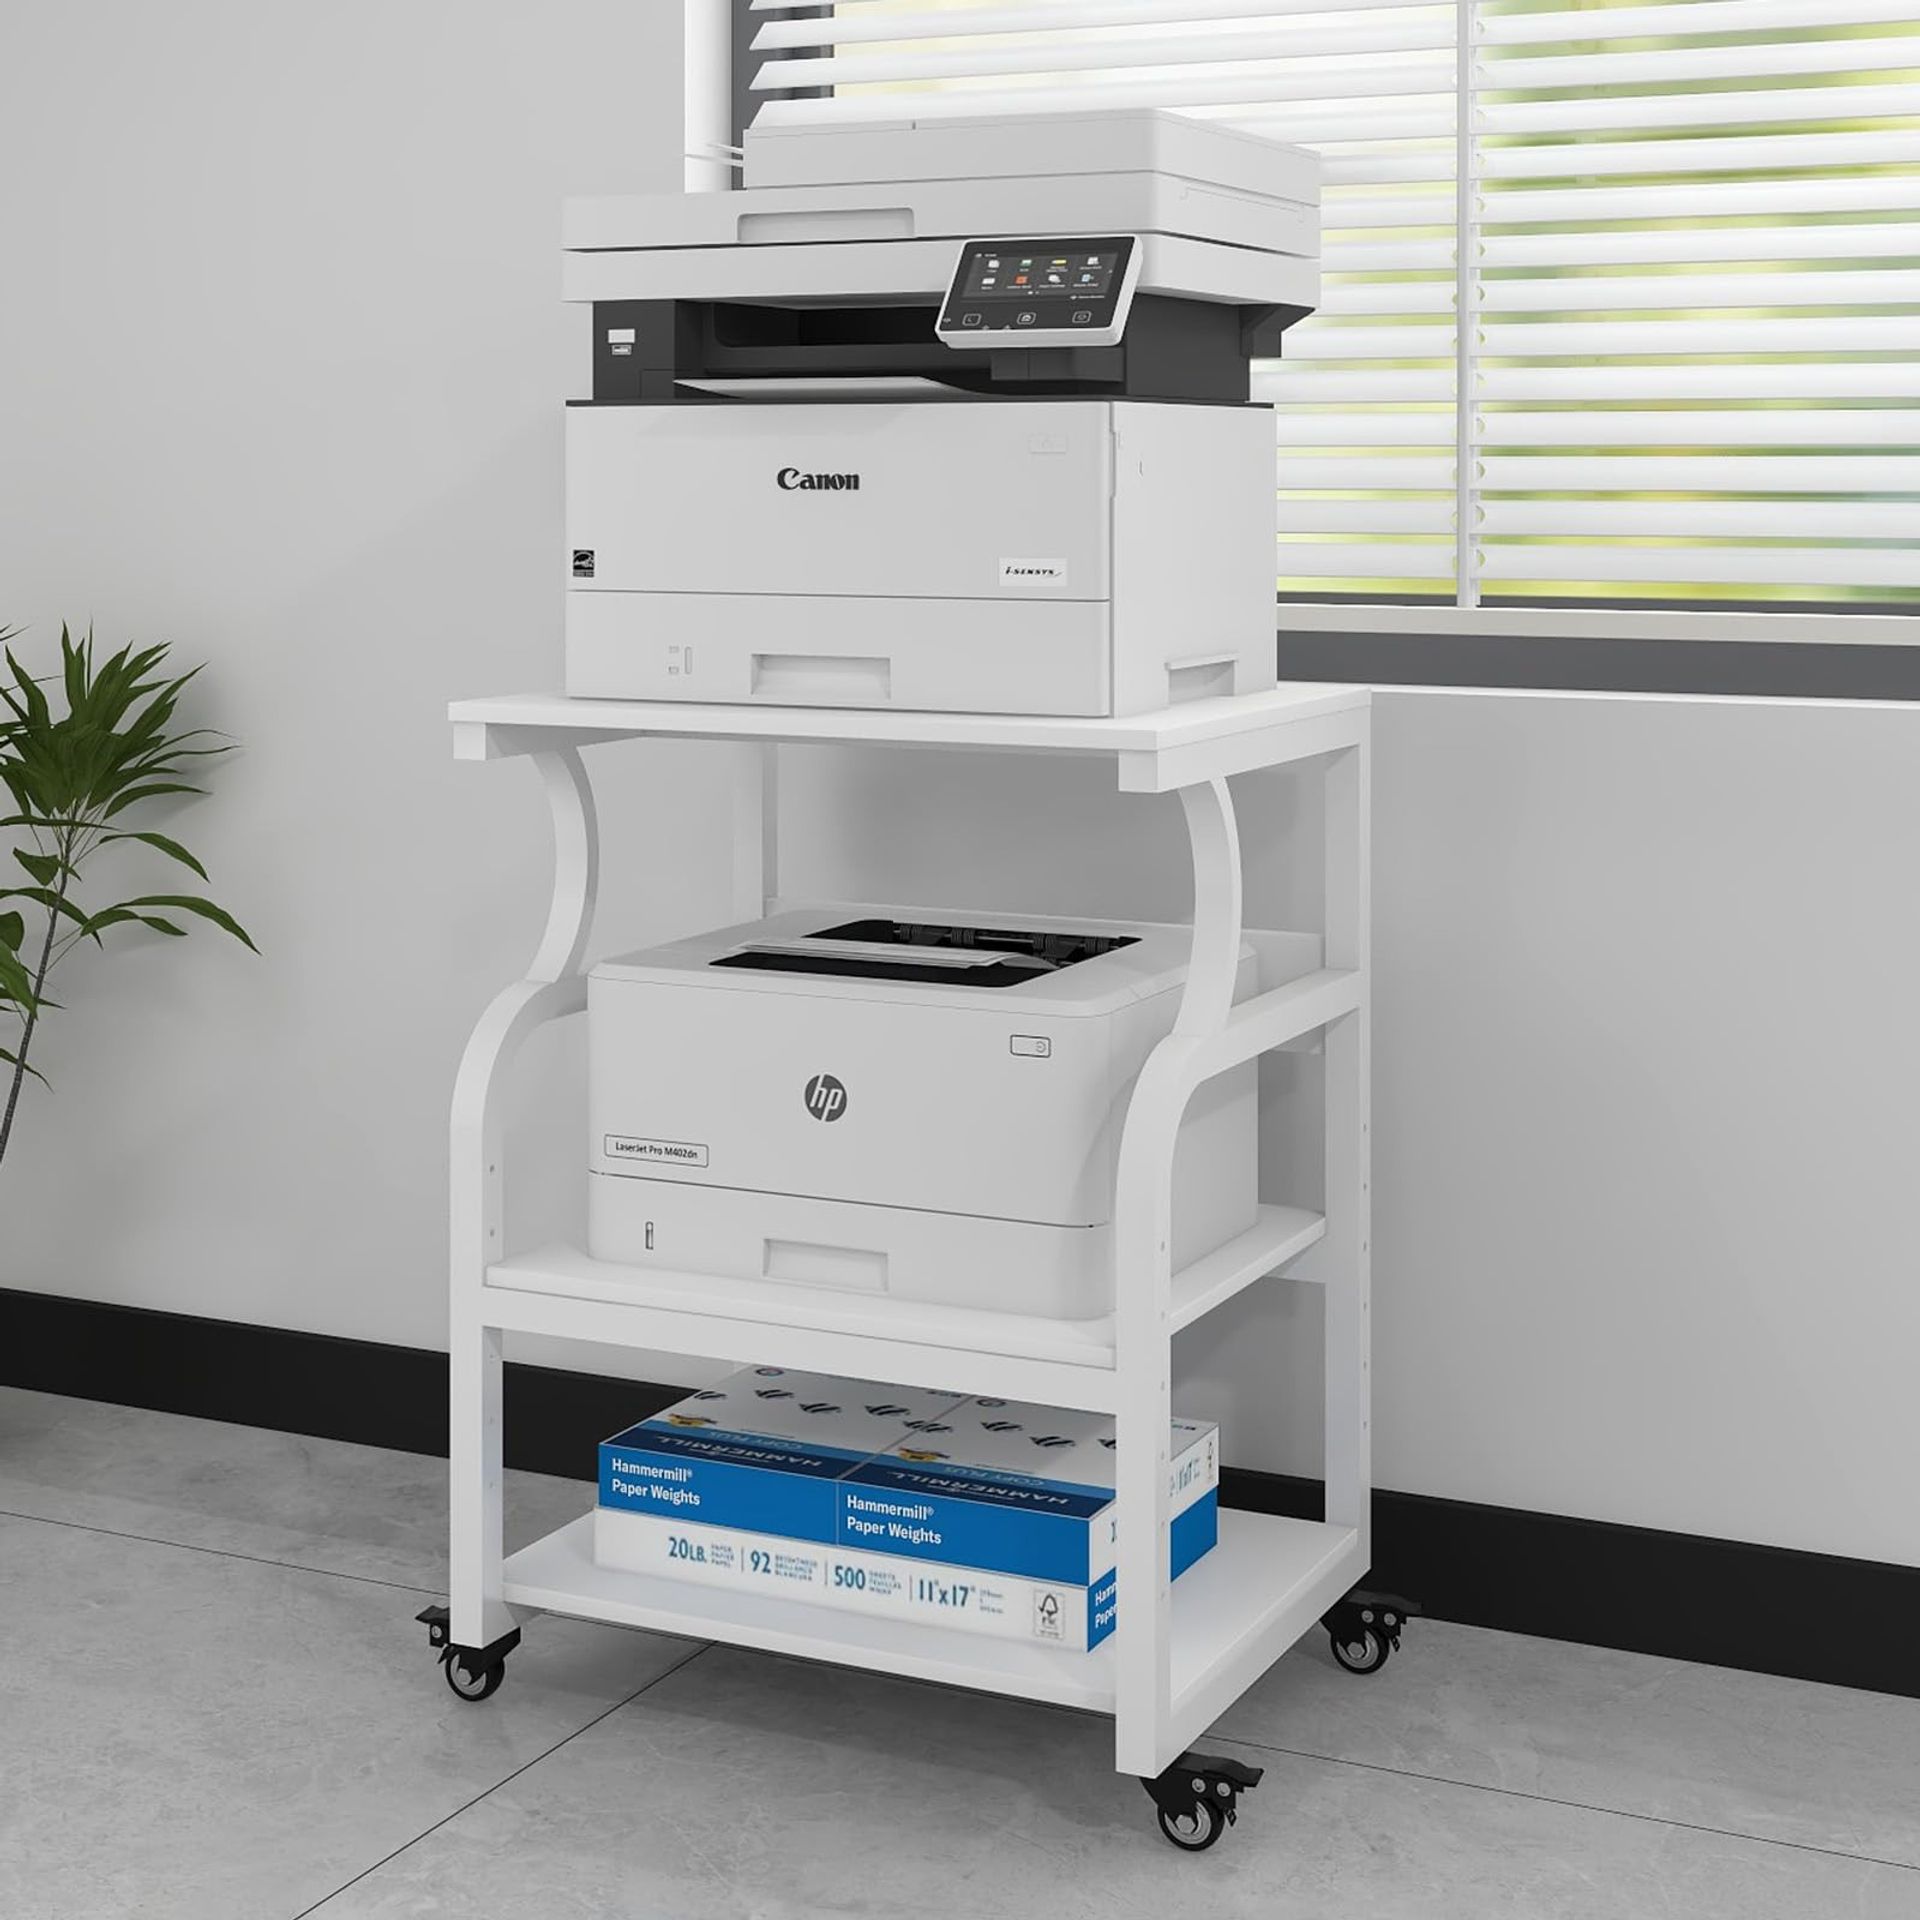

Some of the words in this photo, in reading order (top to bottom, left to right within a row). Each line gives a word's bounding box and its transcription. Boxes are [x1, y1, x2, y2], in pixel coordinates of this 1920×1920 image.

[777, 467, 860, 490] Canon
[808, 1074, 844, 1122] hp
[616, 1142, 647, 1154] LaserJet
[649, 1145, 663, 1156] Pro
[655, 1435, 823, 1468] HAMMERMILL
[612, 1479, 648, 1497] Paper
[650, 1484, 700, 1505] Weights
[885, 1471, 1070, 1505] HAMMERMILL
[847, 1516, 886, 1536] Paper
[888, 1522, 942, 1545] Weights
[750, 1549, 771, 1574] 92
[834, 1564, 866, 1590] 500
